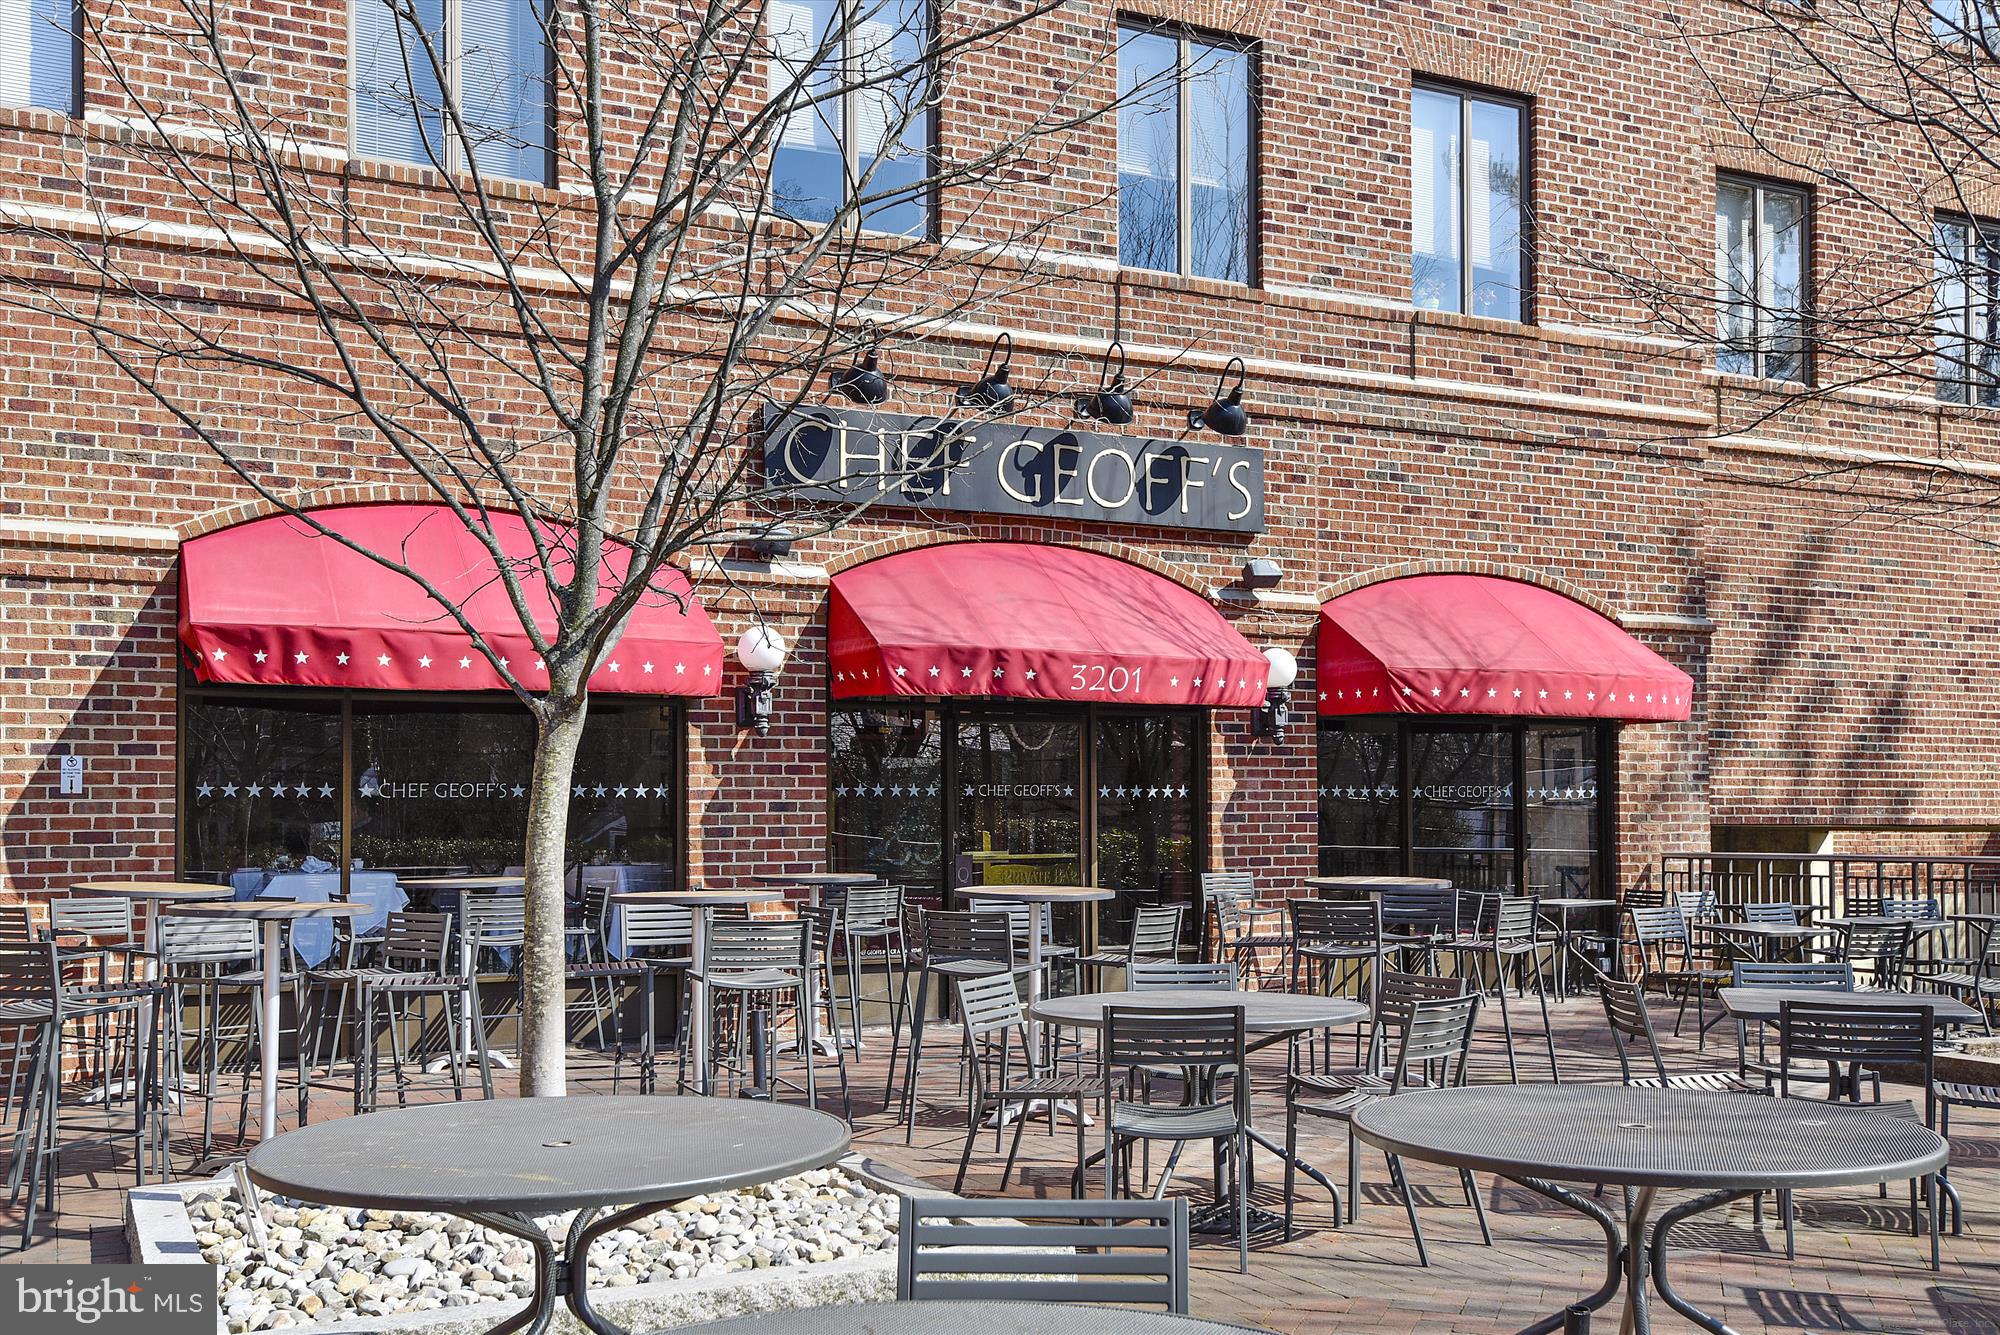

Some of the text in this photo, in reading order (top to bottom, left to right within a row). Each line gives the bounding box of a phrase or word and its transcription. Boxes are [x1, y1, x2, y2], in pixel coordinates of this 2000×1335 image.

[783, 419, 1252, 521] CHEF GEOFF'S
[1070, 664, 1142, 693] 3201
[379, 782, 507, 799] CHEF GEOFF'S
[978, 783, 1061, 797] CHEF GEOFF'S
[1424, 785, 1502, 798] CHEF GEOFF'S
